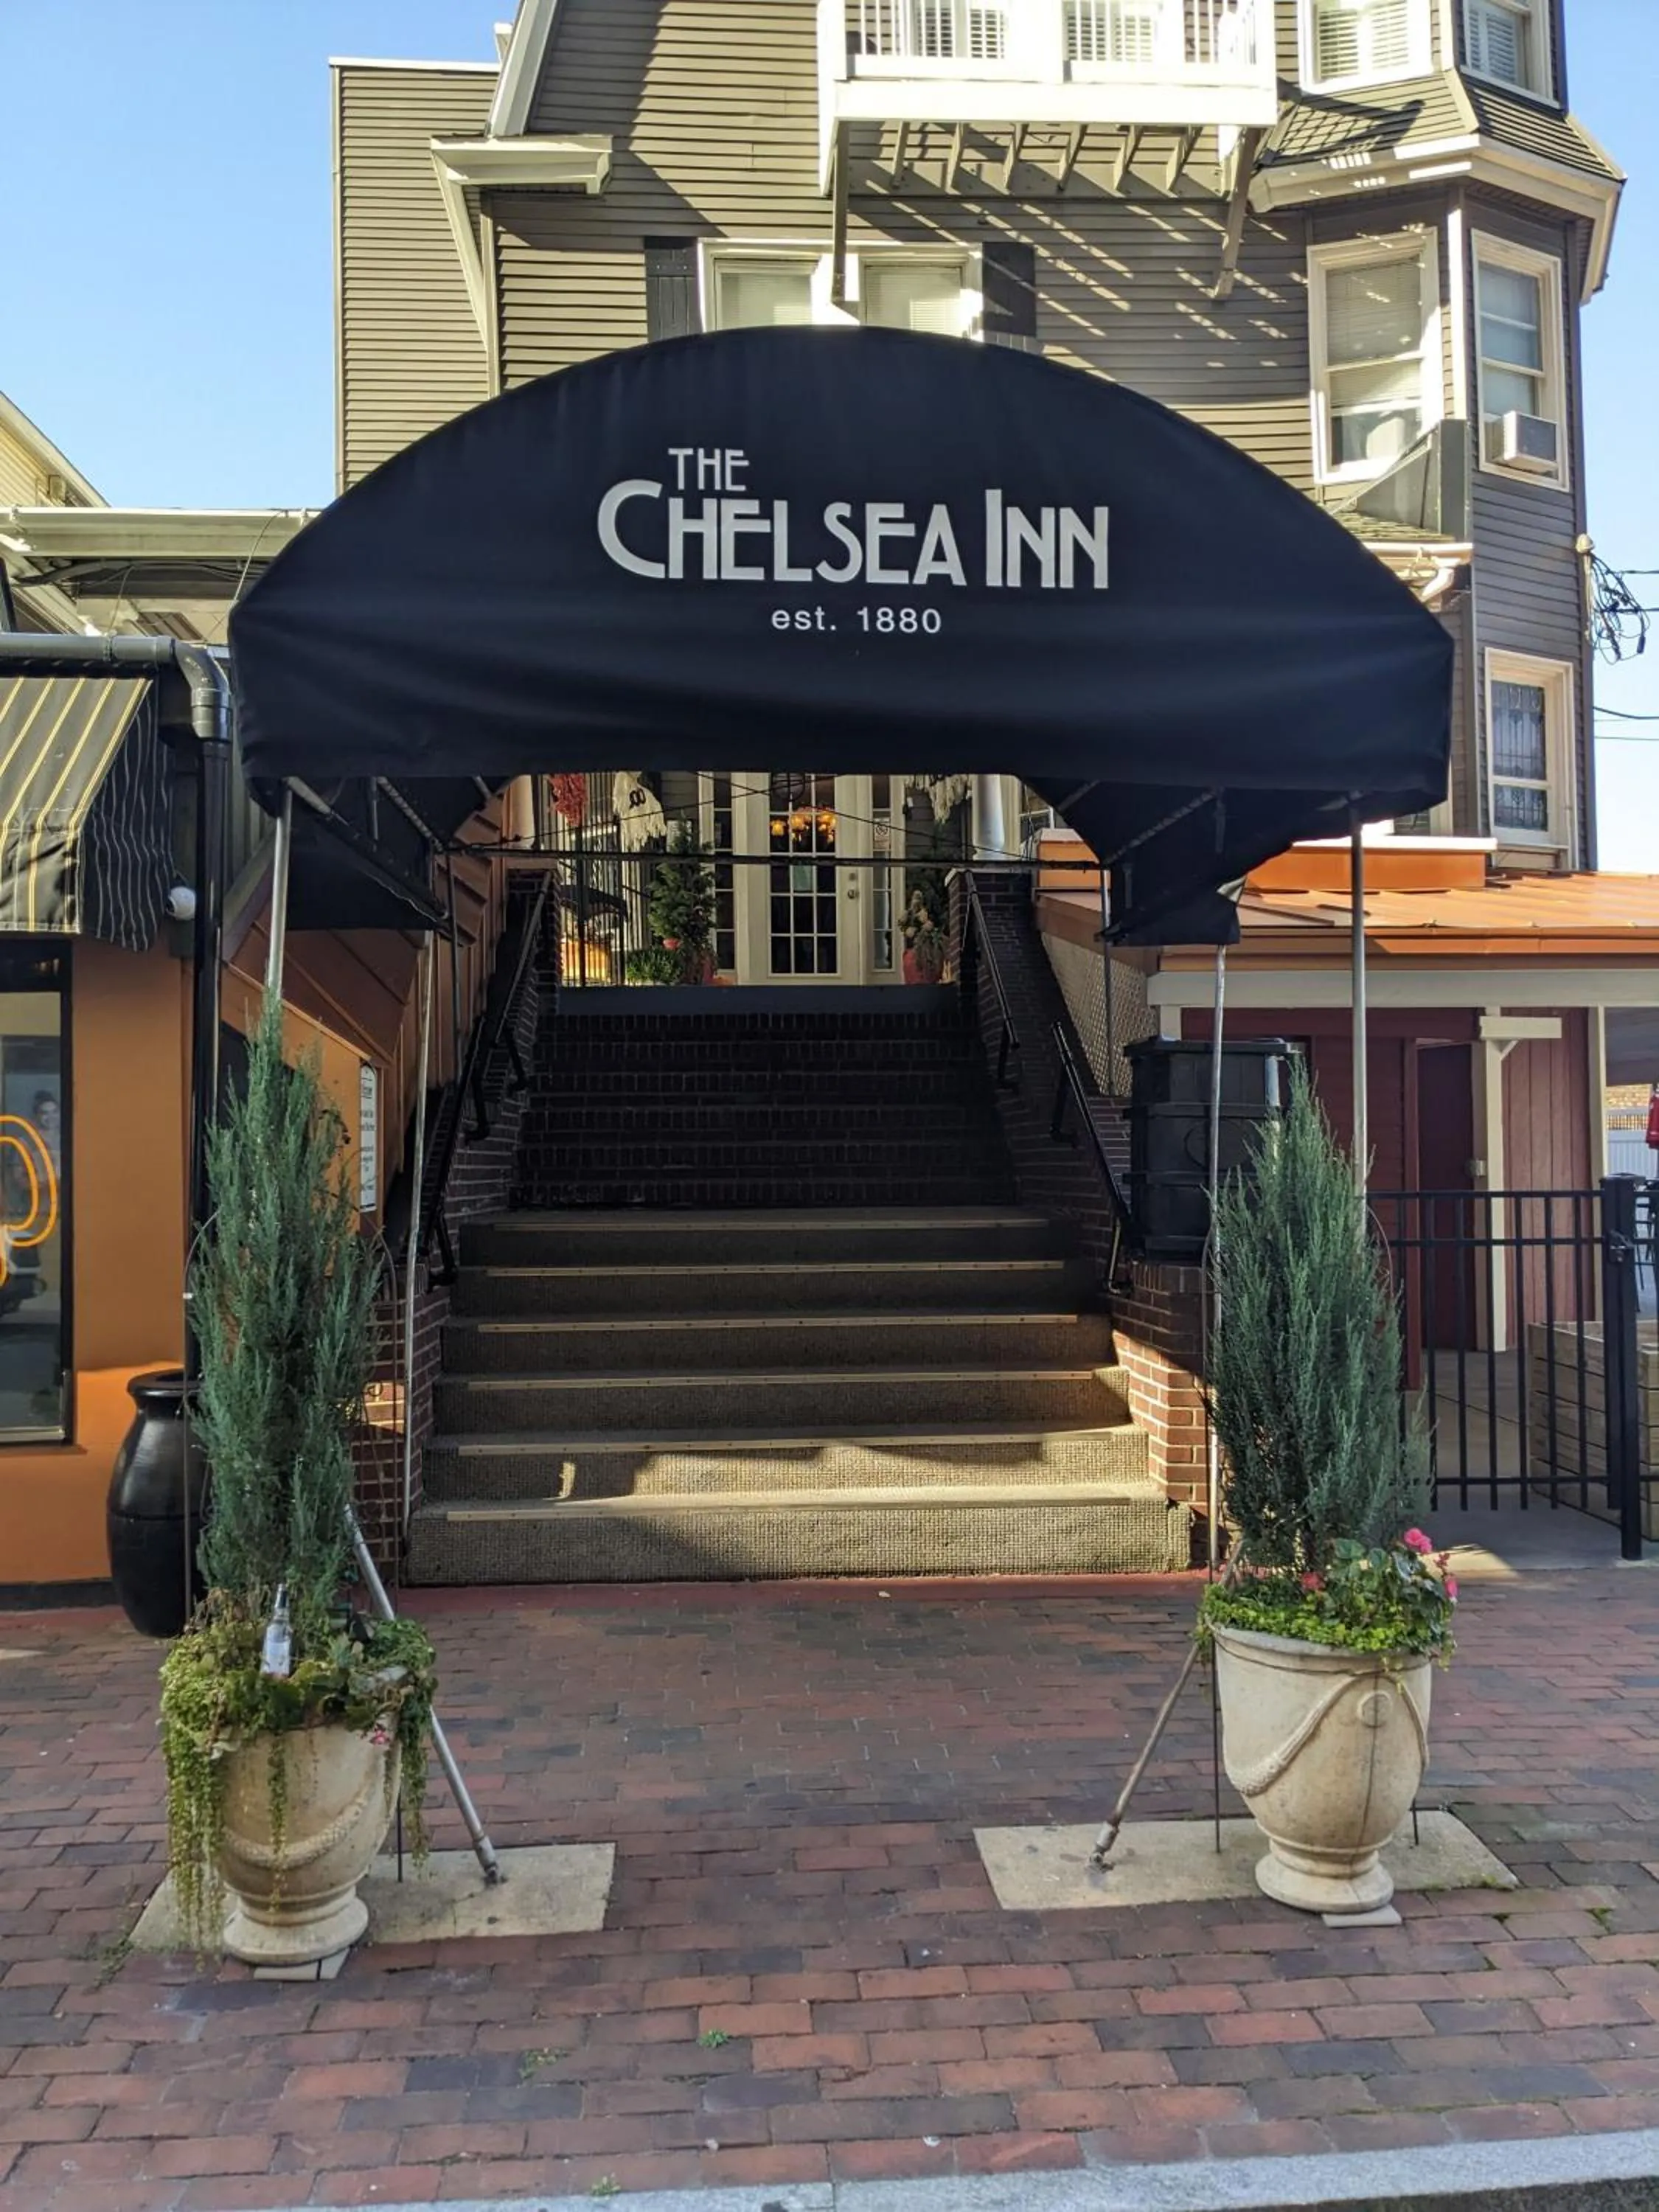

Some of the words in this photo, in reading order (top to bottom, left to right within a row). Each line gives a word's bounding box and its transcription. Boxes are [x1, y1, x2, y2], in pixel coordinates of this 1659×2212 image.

[668, 448, 750, 491] THE
[597, 479, 967, 585] CHELSEA
[985, 489, 1109, 589] INN
[771, 605, 836, 630] est.
[857, 607, 942, 633] 1880
